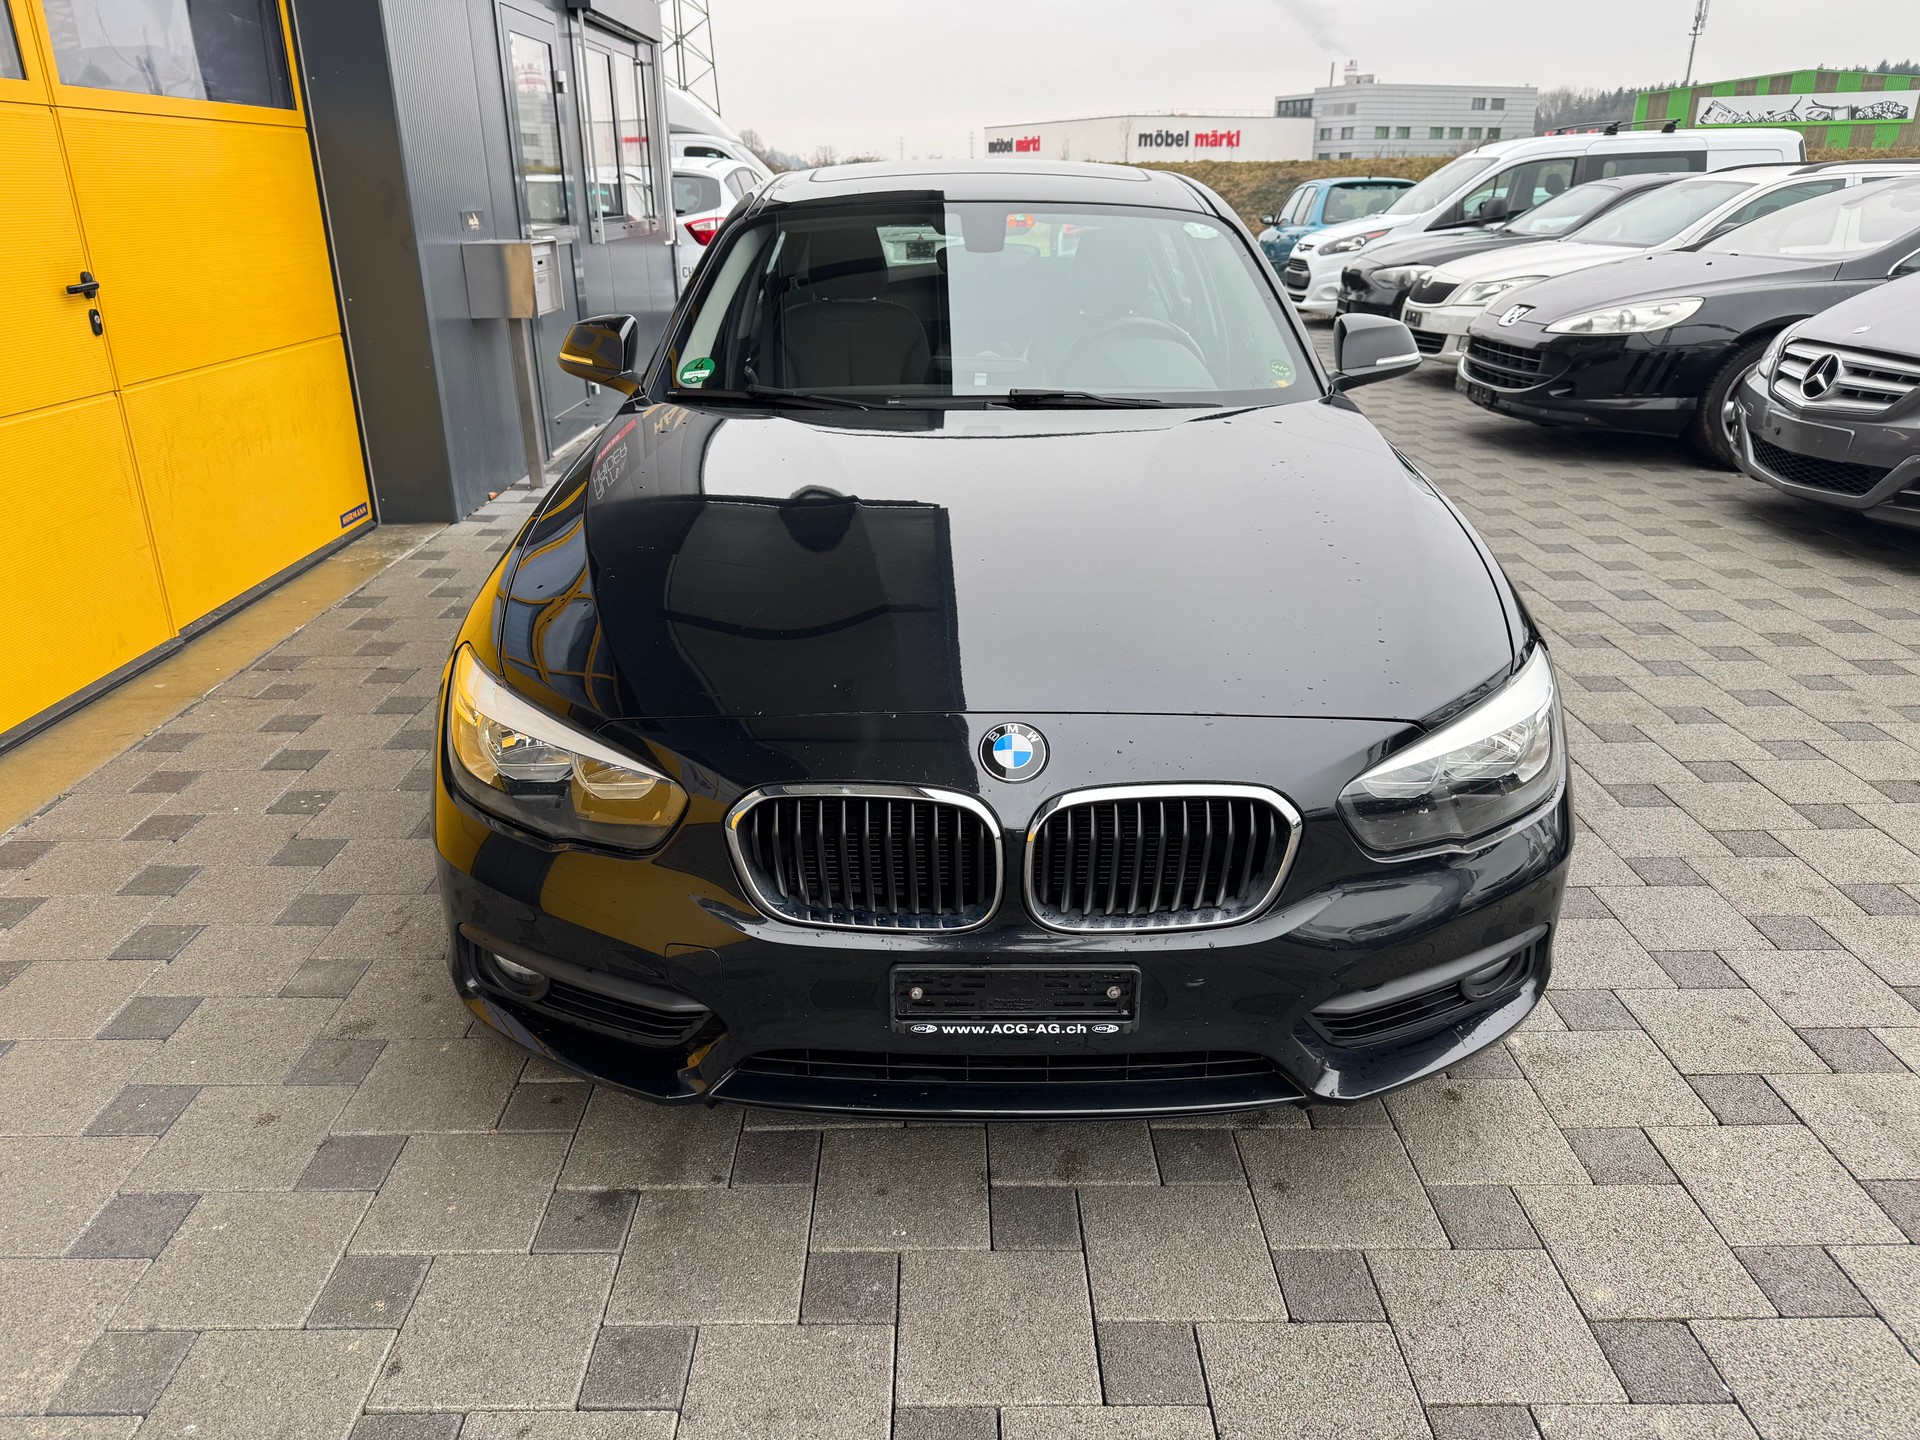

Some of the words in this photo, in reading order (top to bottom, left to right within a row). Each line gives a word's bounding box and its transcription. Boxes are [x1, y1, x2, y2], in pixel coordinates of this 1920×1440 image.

[988, 138, 1013, 153] möbel
[1016, 135, 1041, 152] märki
[1138, 129, 1189, 147] möbel
[1195, 129, 1240, 147] märki
[694, 359, 704, 370] 4
[941, 1024, 1087, 1034] www.ACG-AG.ch
